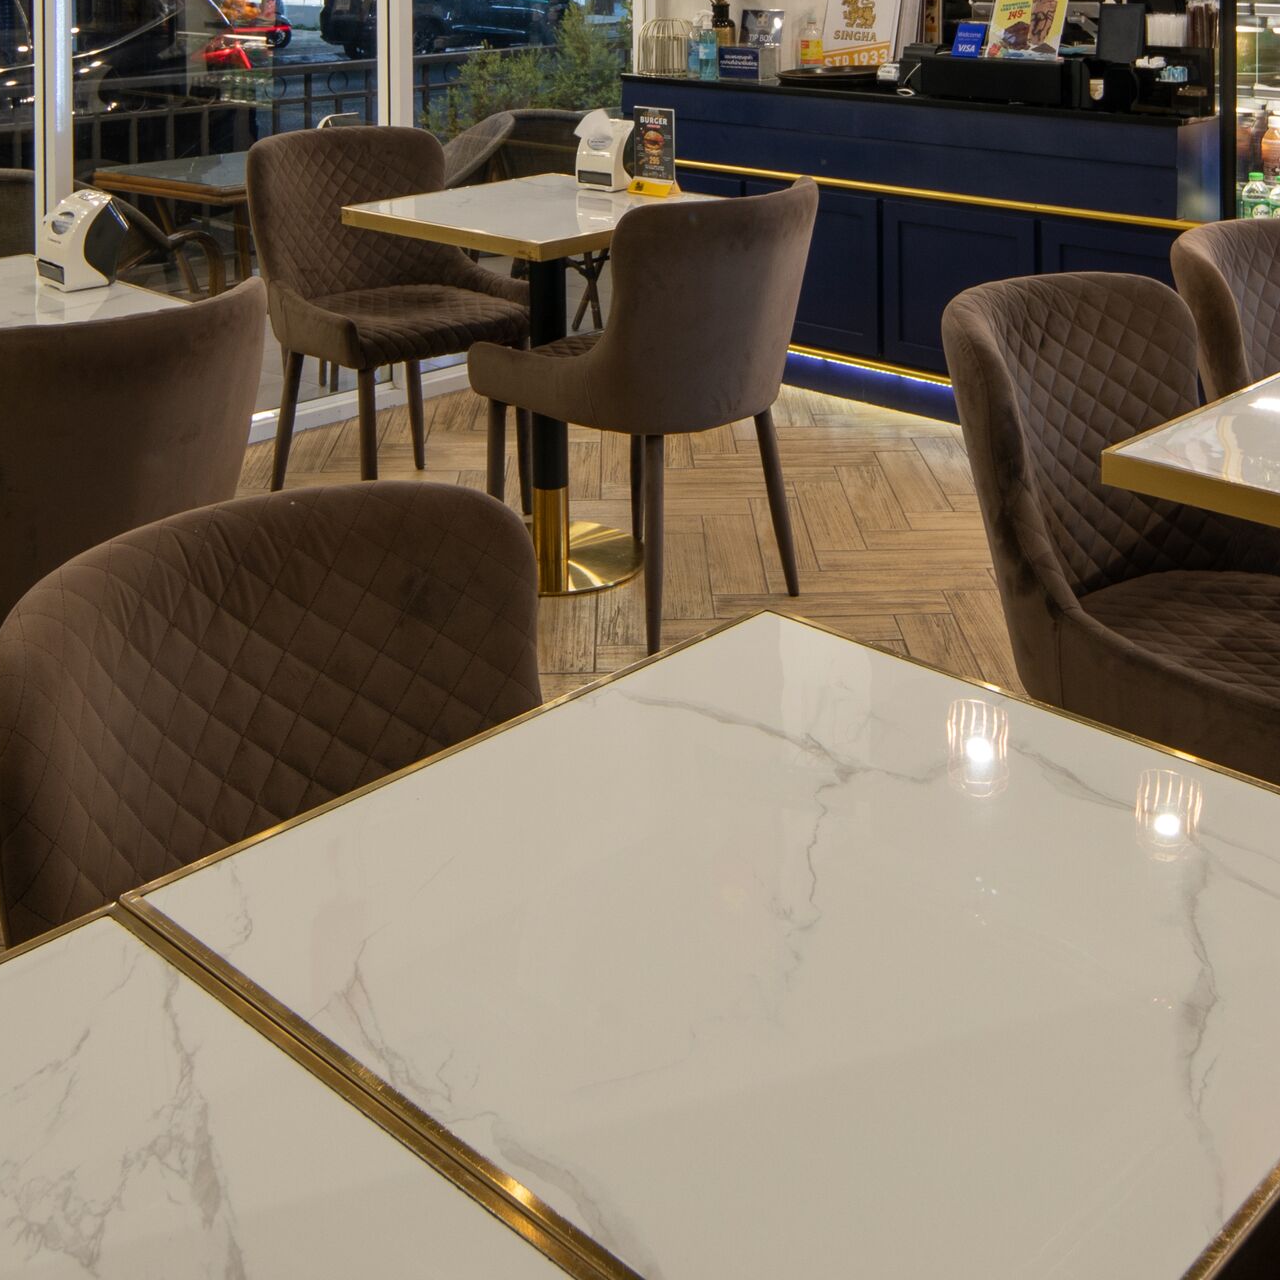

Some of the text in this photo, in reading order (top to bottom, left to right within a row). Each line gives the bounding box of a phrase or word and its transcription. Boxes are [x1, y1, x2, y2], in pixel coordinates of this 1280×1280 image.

[833, 30, 877, 42] SINGHA
[957, 44, 975, 52] VISA
[853, 49, 889, 66] 1933
[640, 116, 668, 126] BURGER
